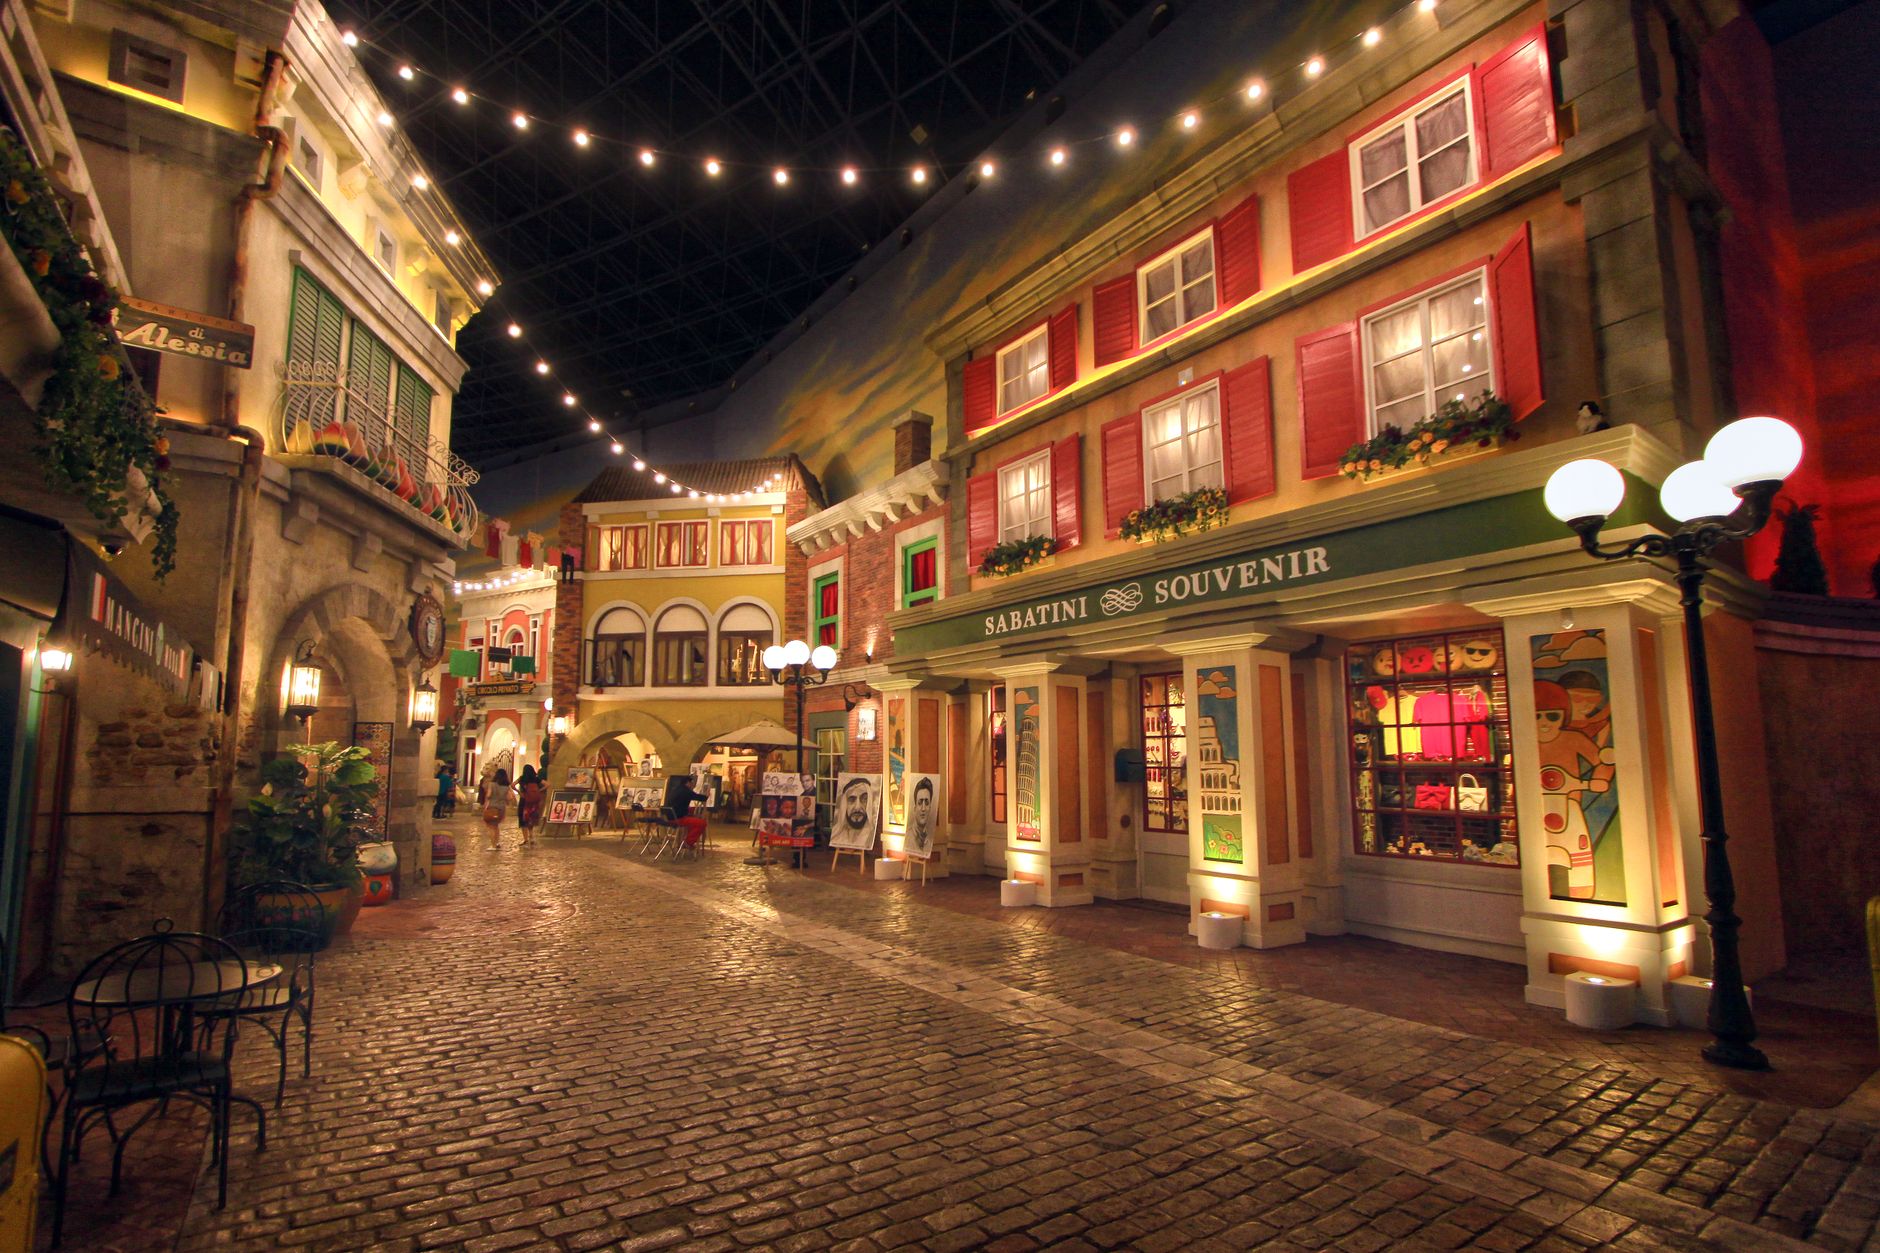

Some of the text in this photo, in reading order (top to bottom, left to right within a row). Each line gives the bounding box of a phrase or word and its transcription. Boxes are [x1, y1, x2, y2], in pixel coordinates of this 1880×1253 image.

[123, 322, 248, 365] Alessia
[188, 327, 206, 340] di
[985, 546, 1331, 636] SABATINI SOUVENIR
